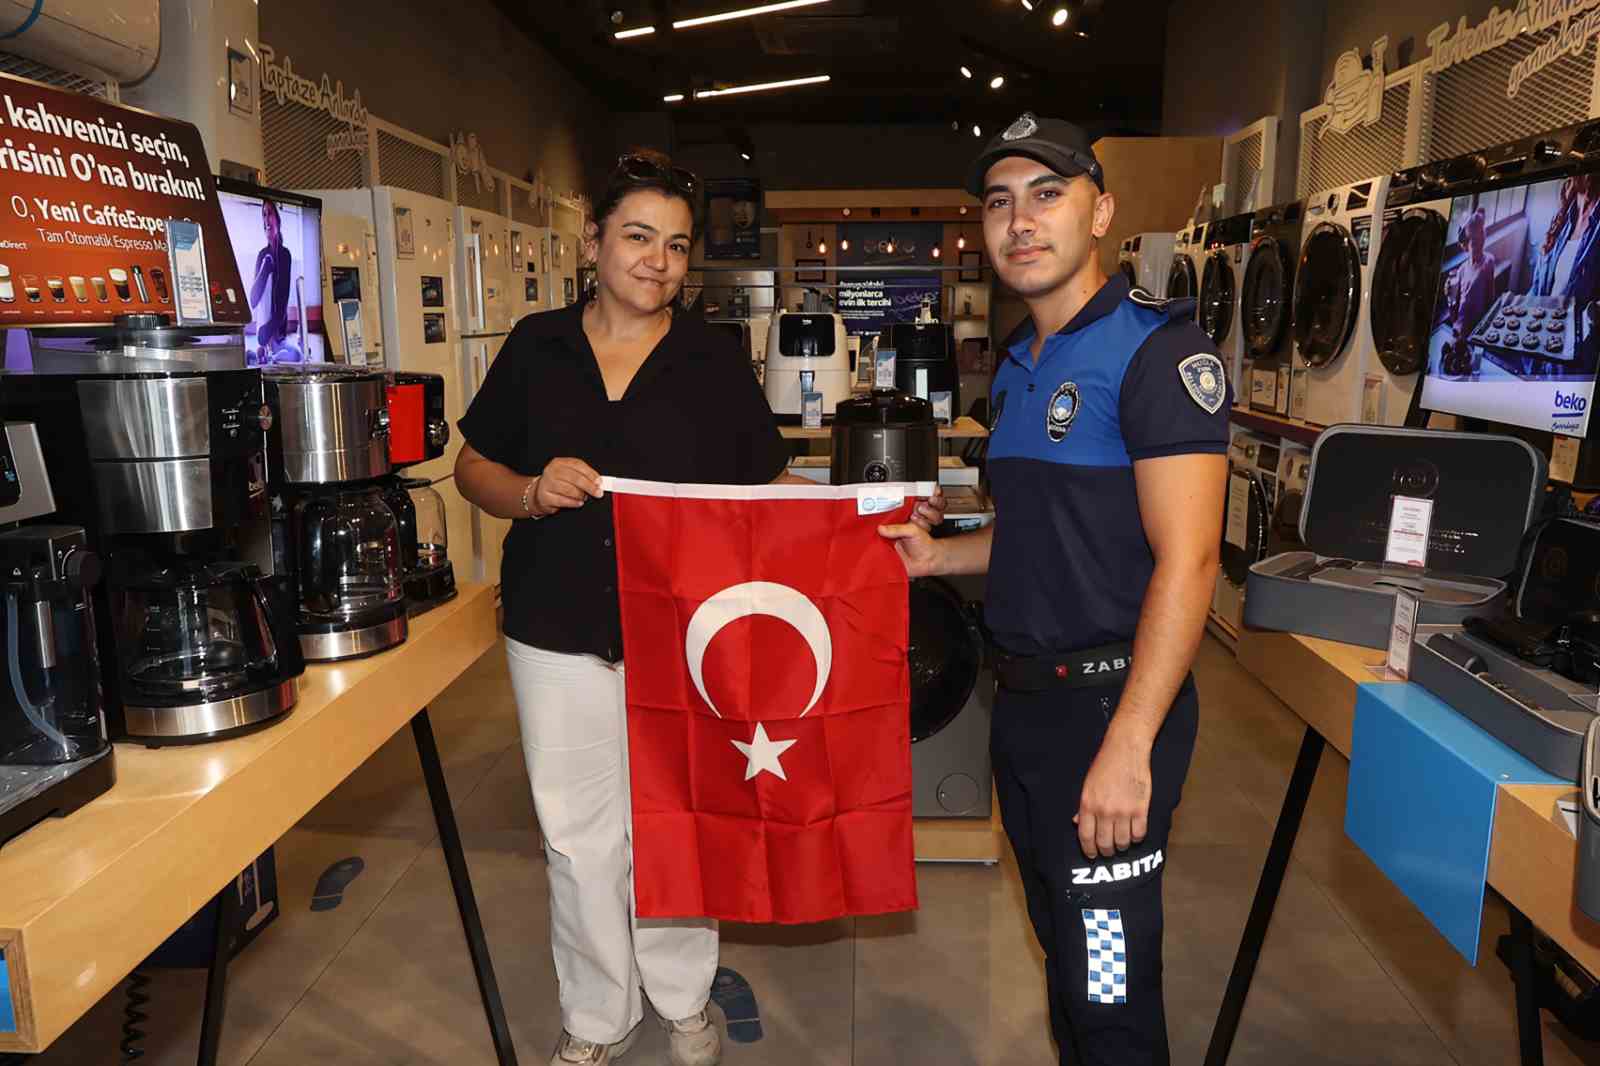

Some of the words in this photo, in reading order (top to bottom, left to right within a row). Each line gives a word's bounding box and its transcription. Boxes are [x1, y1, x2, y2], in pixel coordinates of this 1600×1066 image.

[4, 95, 129, 150] kahvenizi
[131, 131, 190, 168] seçin,
[128, 161, 206, 201] bırakın!
[34, 197, 78, 224] Yeni
[83, 203, 169, 233] CaffeExpe
[37, 227, 63, 244] Tam
[65, 229, 112, 249] Otomatik
[113, 236, 153, 251] Espresso
[838, 289, 884, 299] milyonlarca
[1554, 390, 1587, 412] beko
[1082, 656, 1132, 674] ZAB
[1071, 850, 1164, 884] ZABITA
